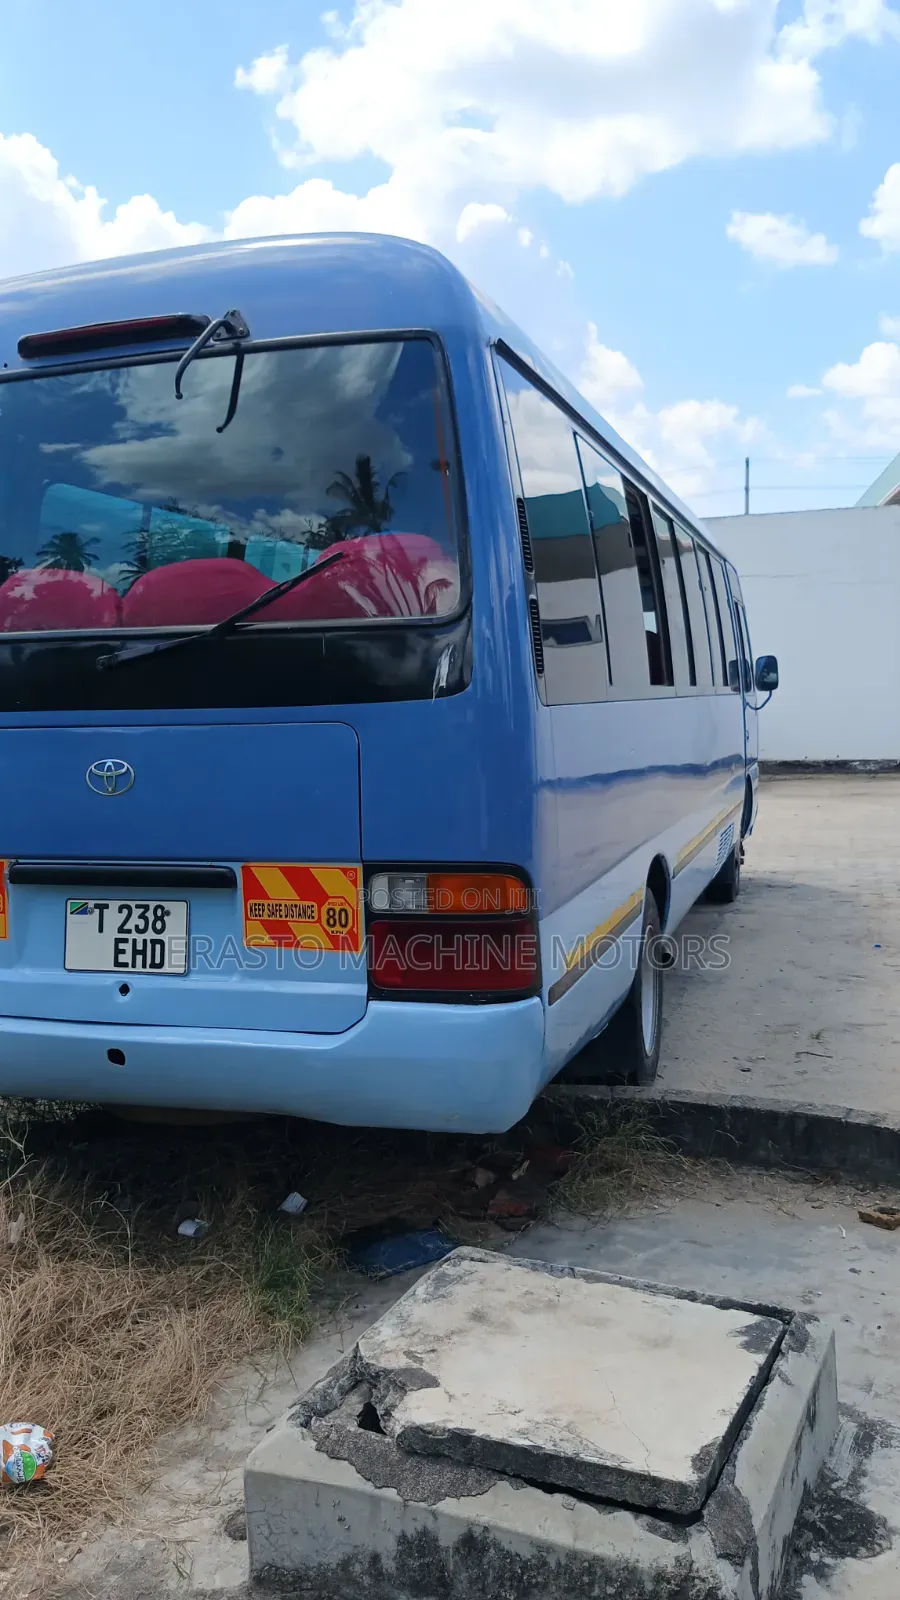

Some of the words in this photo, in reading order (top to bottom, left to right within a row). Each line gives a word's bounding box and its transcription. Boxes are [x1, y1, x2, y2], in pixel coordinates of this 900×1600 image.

[94, 903, 109, 933] T
[117, 904, 166, 935] 238
[249, 903, 265, 917] KEEP
[267, 903, 283, 918] SAFE
[284, 904, 315, 919] DISTANCE
[326, 907, 349, 928] 80
[113, 937, 165, 969] EHD
